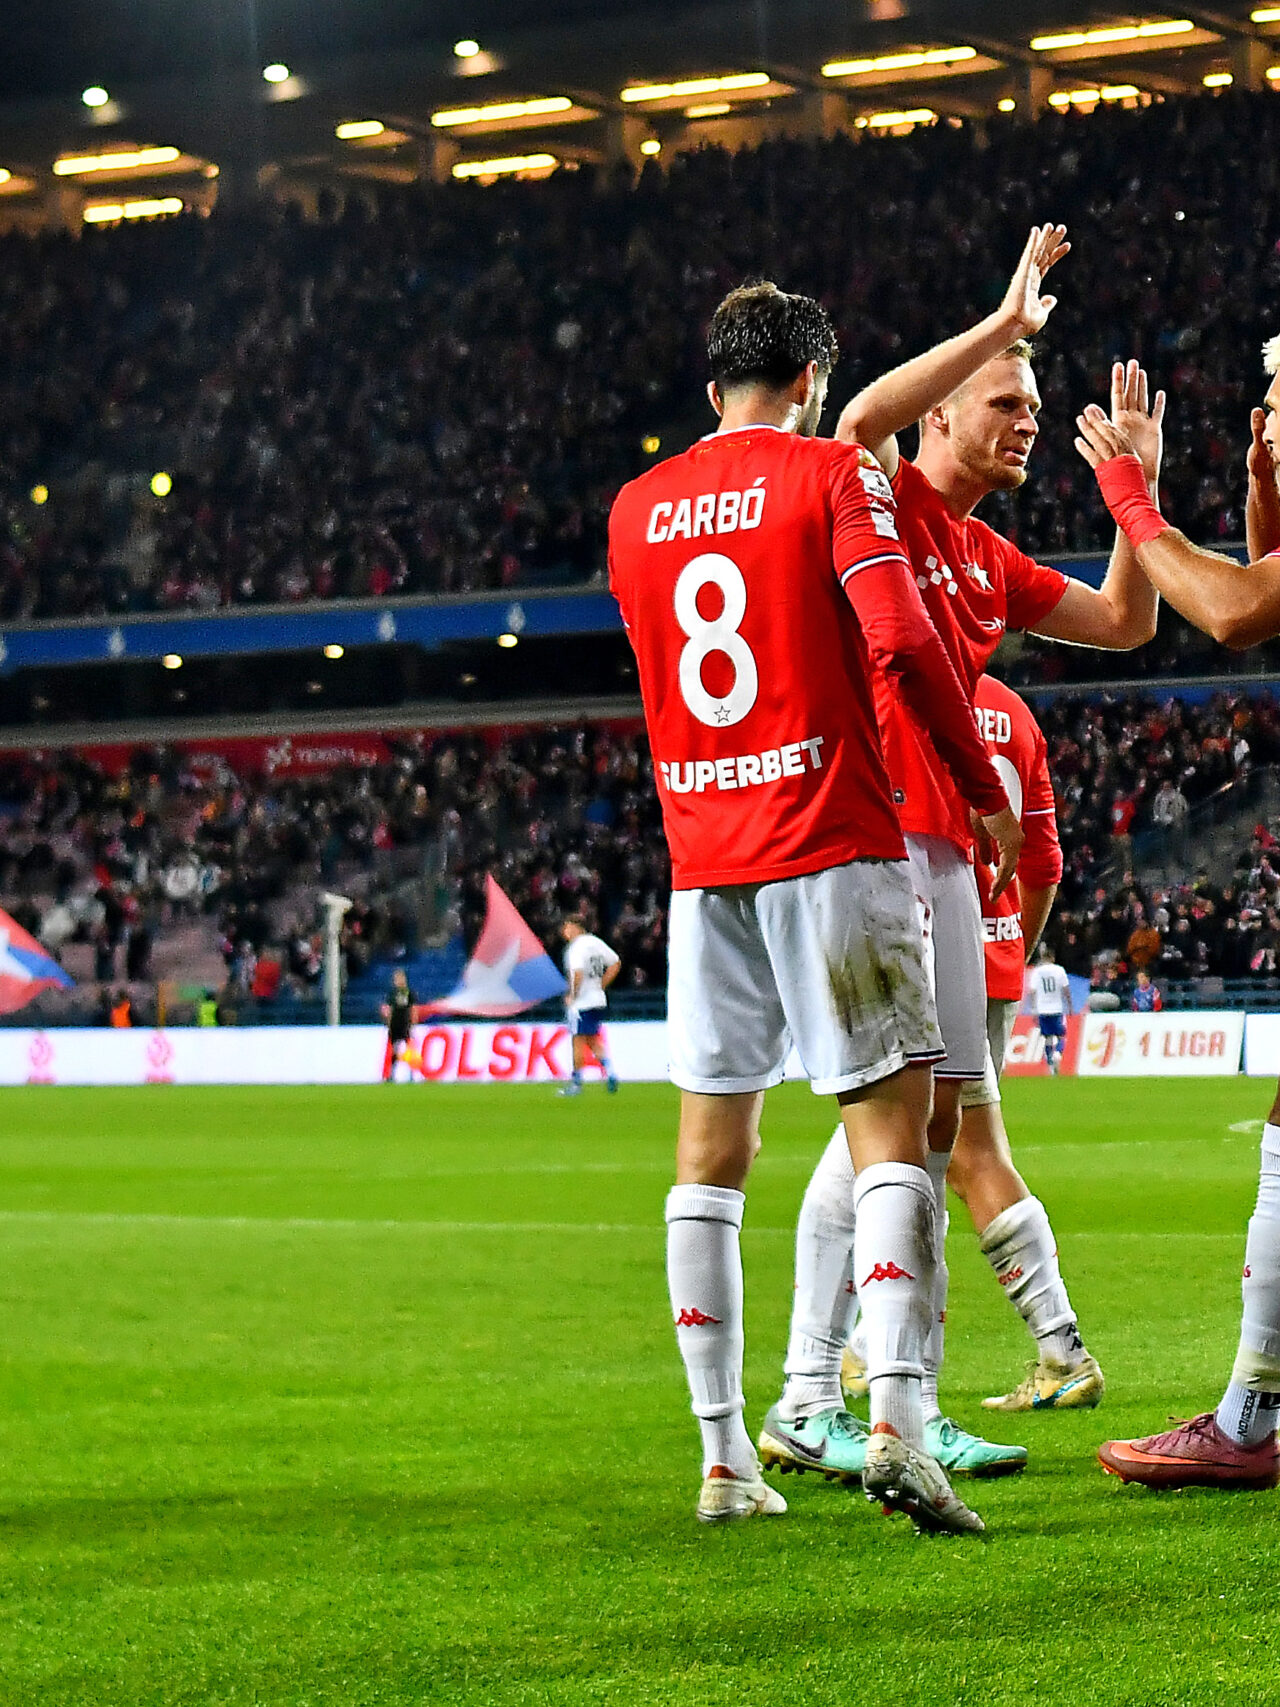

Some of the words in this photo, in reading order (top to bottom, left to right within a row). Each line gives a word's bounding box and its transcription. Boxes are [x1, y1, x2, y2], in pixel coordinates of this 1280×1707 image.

[646, 477, 767, 544] CARBÓ
[674, 553, 759, 728] 8
[974, 706, 1012, 744] RED
[1040, 976, 1056, 993] 10
[1138, 1031, 1150, 1057] 1
[1163, 1030, 1226, 1058] LIGA
[1236, 1389, 1258, 1438] PEDESIGN
